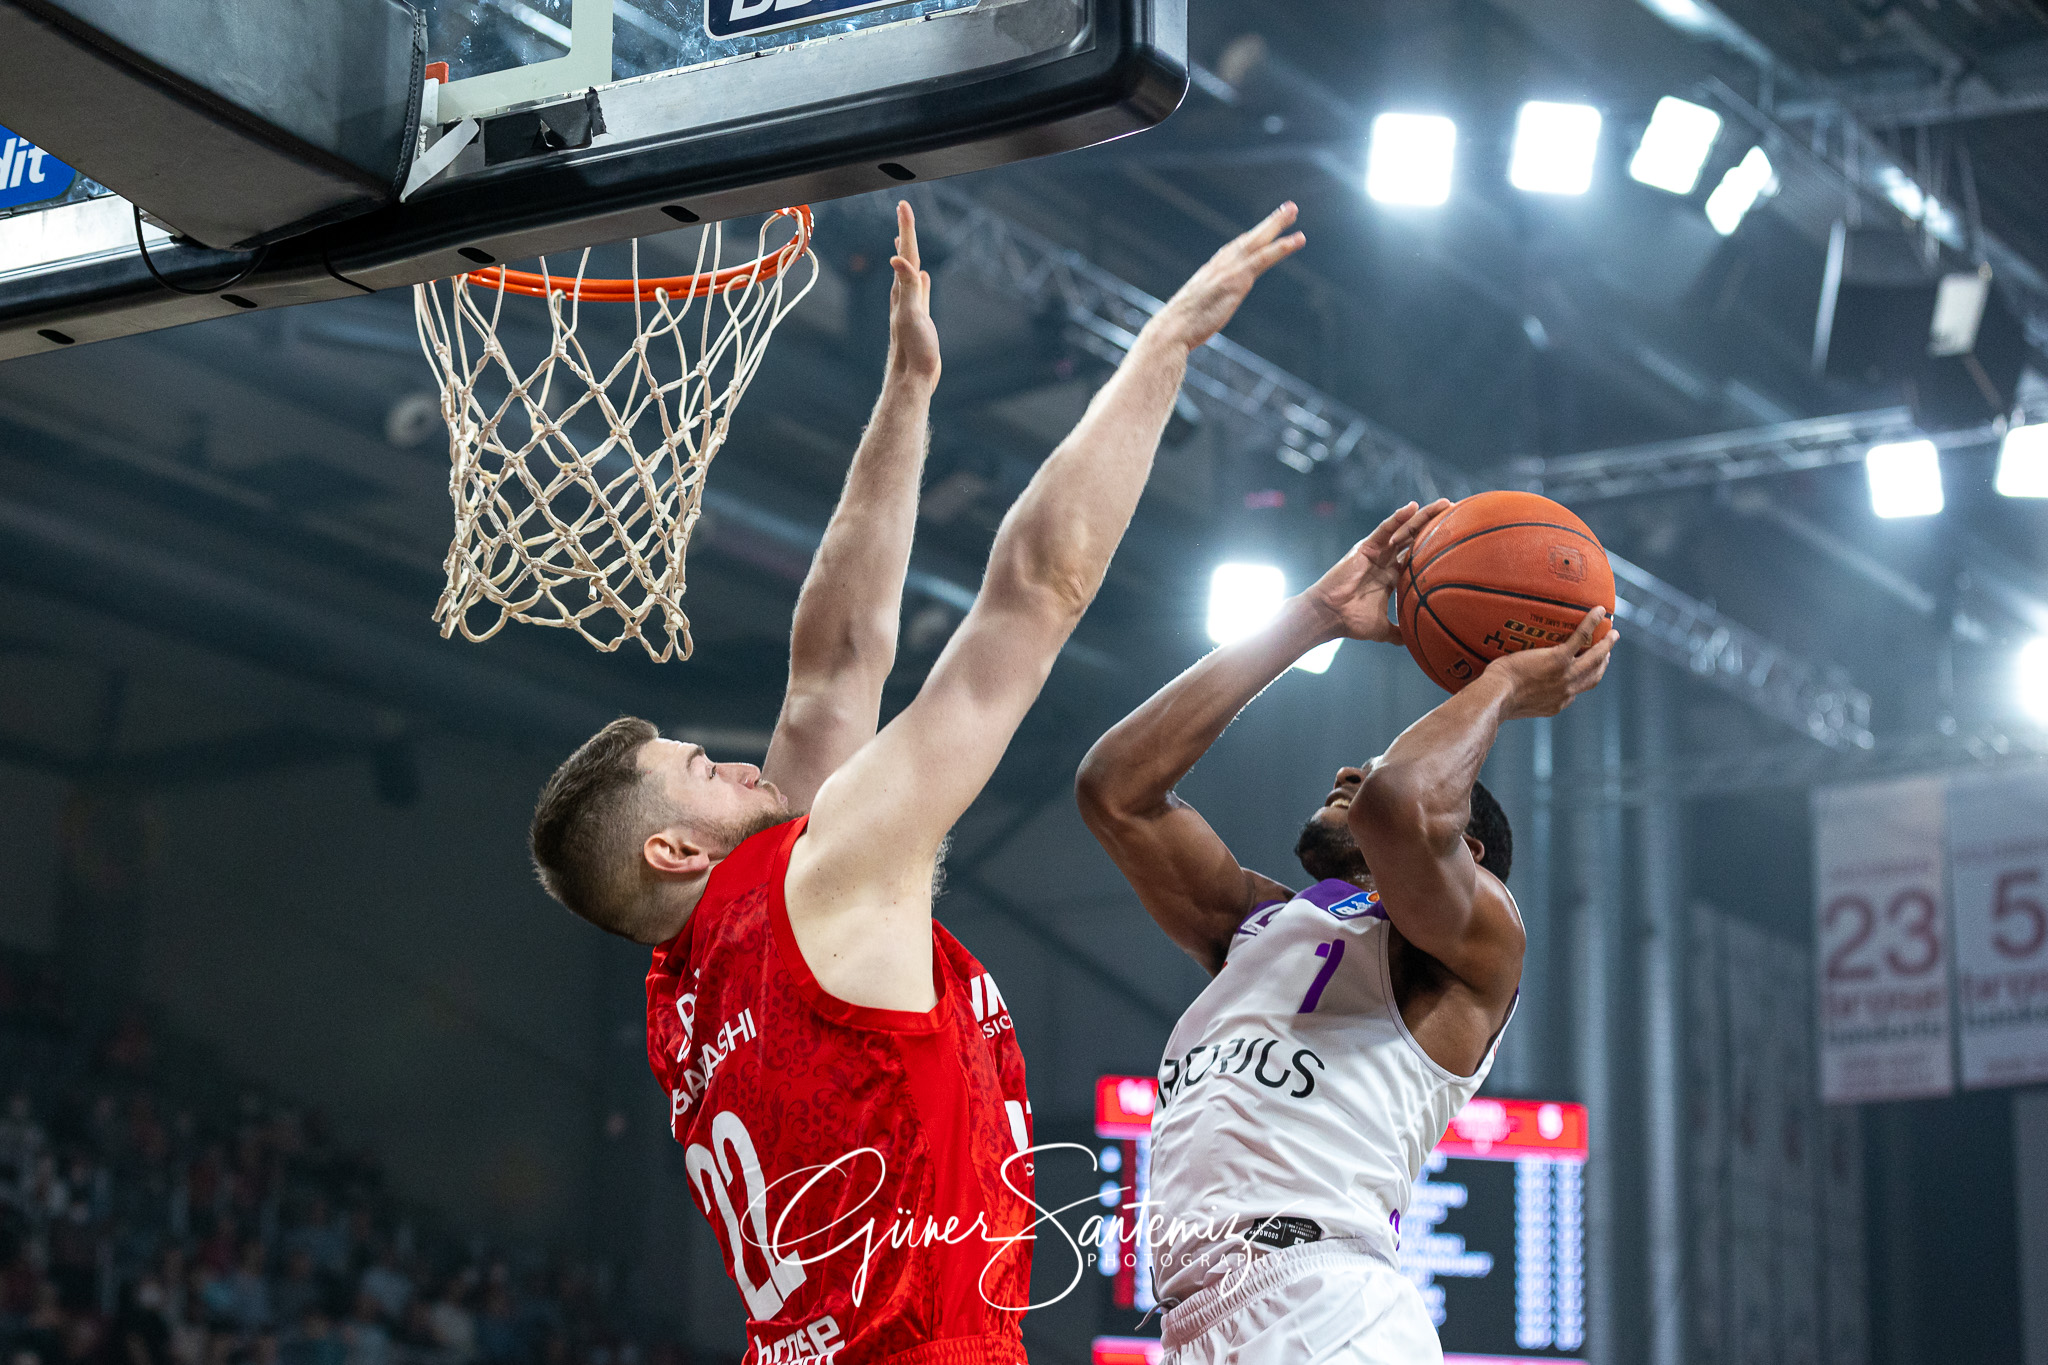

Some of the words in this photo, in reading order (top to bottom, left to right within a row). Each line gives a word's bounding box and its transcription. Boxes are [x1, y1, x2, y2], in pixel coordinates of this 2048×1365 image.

[1824, 888, 1940, 979] 23
[1991, 866, 2048, 959] 5
[686, 1110, 807, 1321] 22
